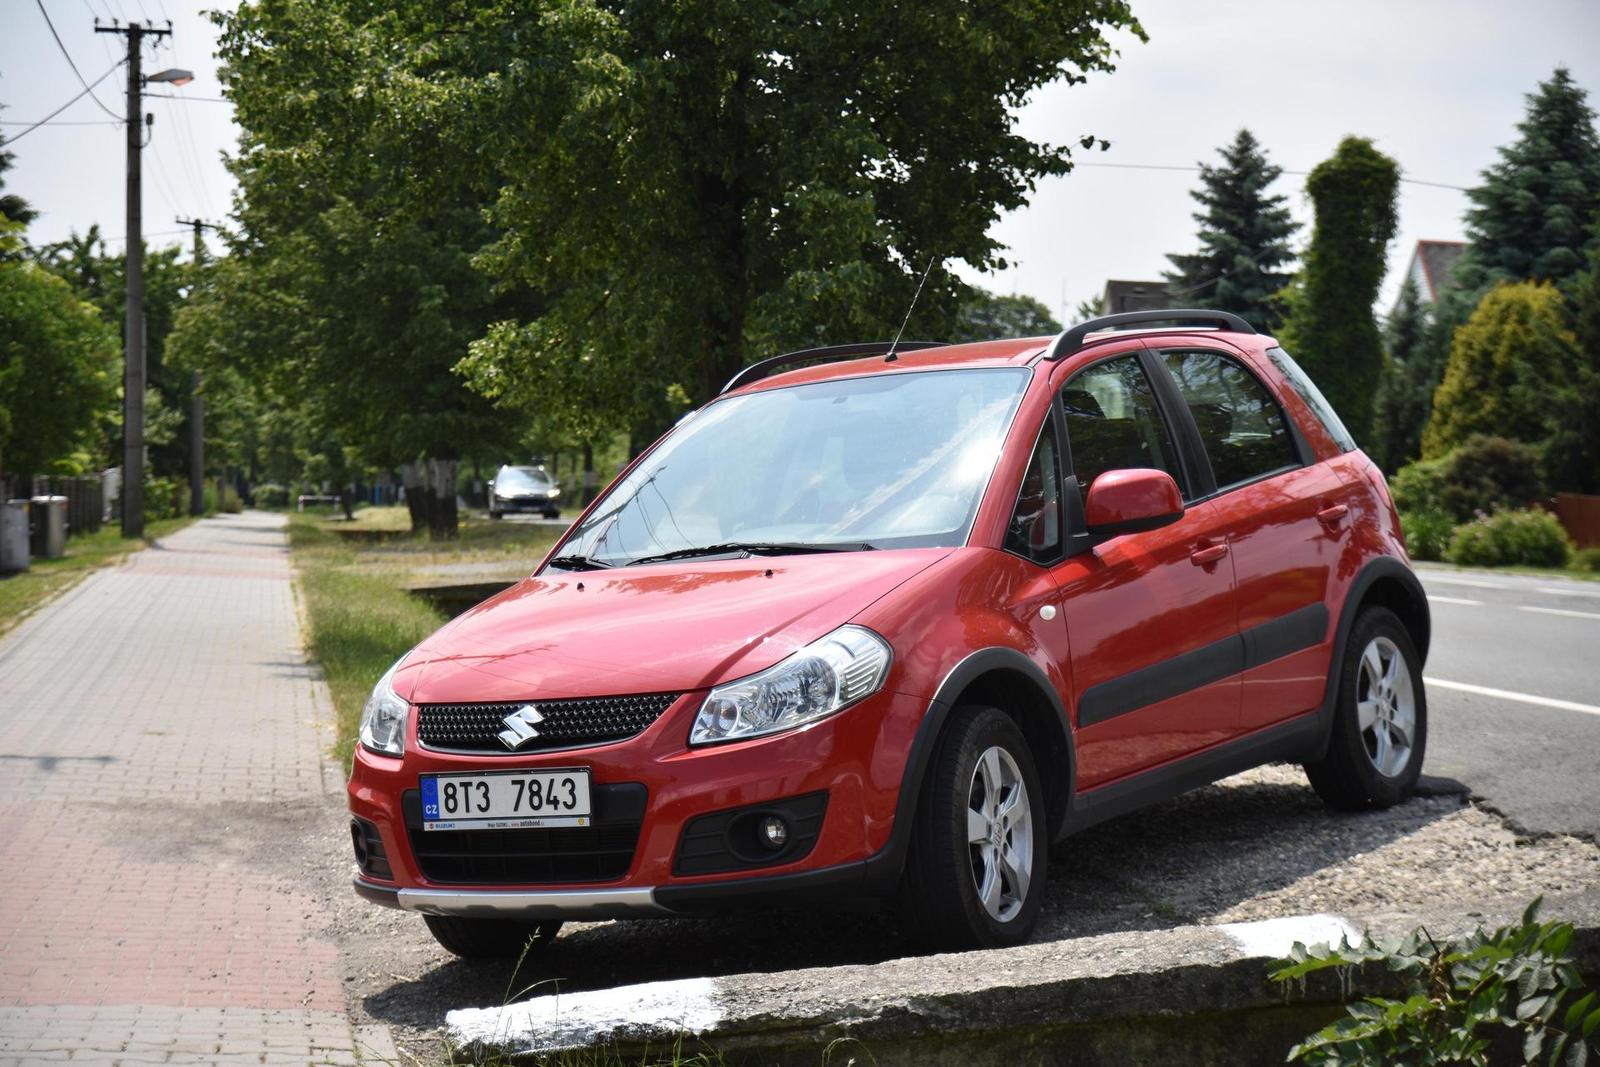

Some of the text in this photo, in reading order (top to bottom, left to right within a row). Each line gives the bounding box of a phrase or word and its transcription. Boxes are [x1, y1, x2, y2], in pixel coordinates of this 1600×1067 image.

[444, 778, 576, 814] 8T3 7843
[425, 805, 438, 814] CZ
